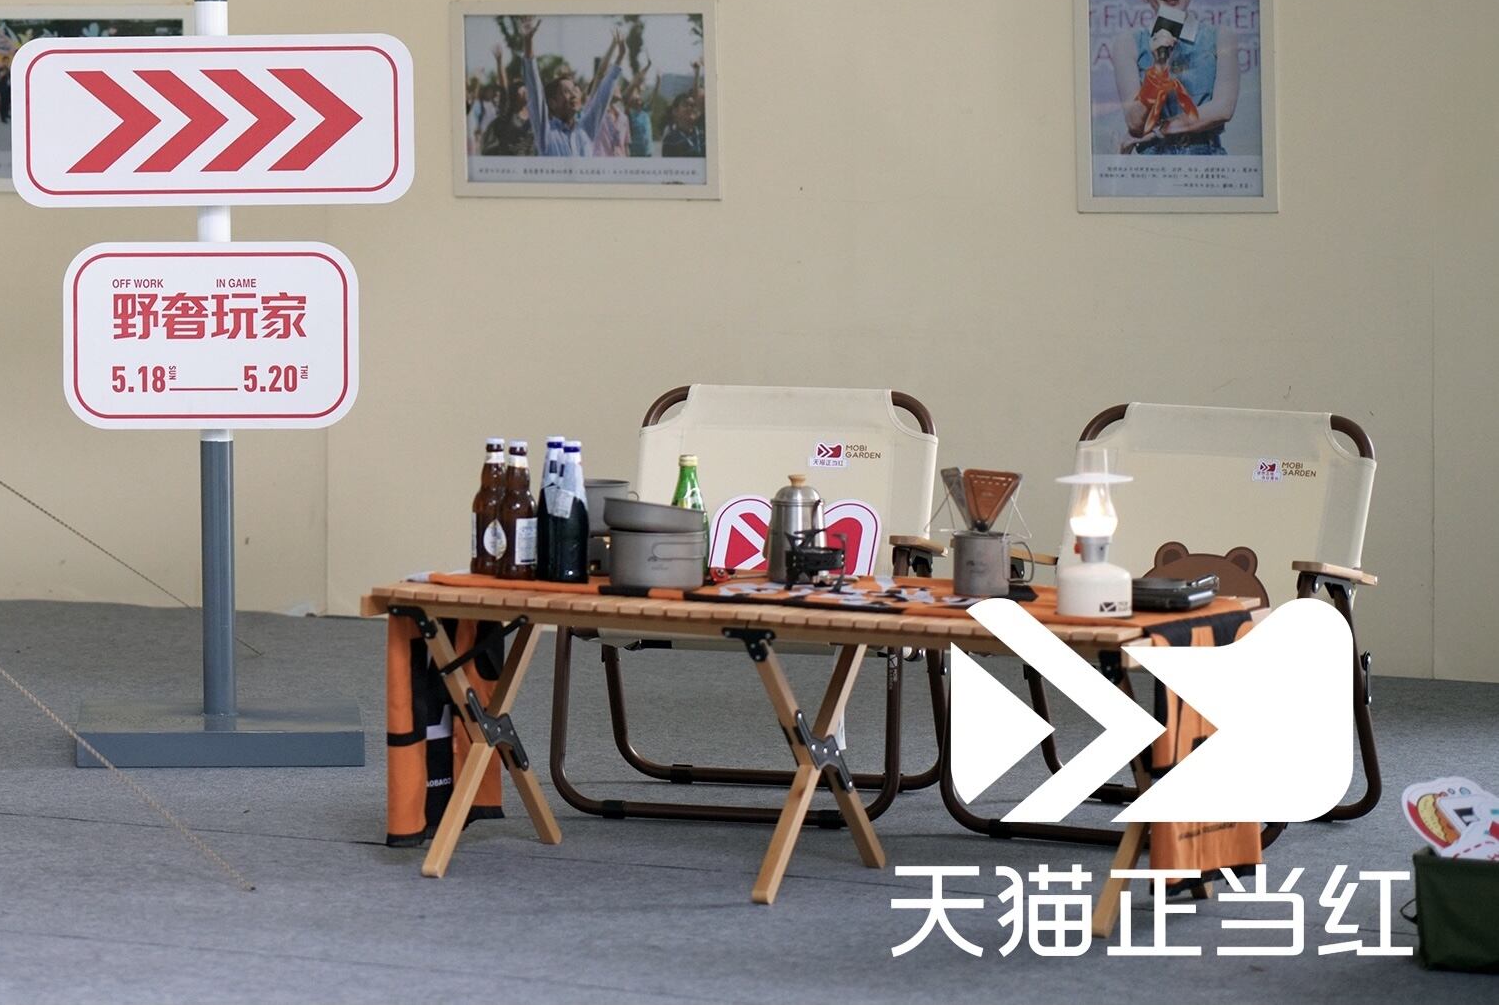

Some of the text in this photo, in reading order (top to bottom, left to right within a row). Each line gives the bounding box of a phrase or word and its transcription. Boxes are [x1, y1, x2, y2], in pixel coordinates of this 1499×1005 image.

[112, 278, 164, 289] OFF WORK
[216, 278, 257, 288] IN GAME
[112, 292, 308, 340] 野奢玩家
[112, 364, 309, 393] 5.18 SUN 5.20 THU
[845, 444, 868, 452] MOBI
[845, 451, 882, 459] GARDEN
[1281, 461, 1304, 470] MOBI
